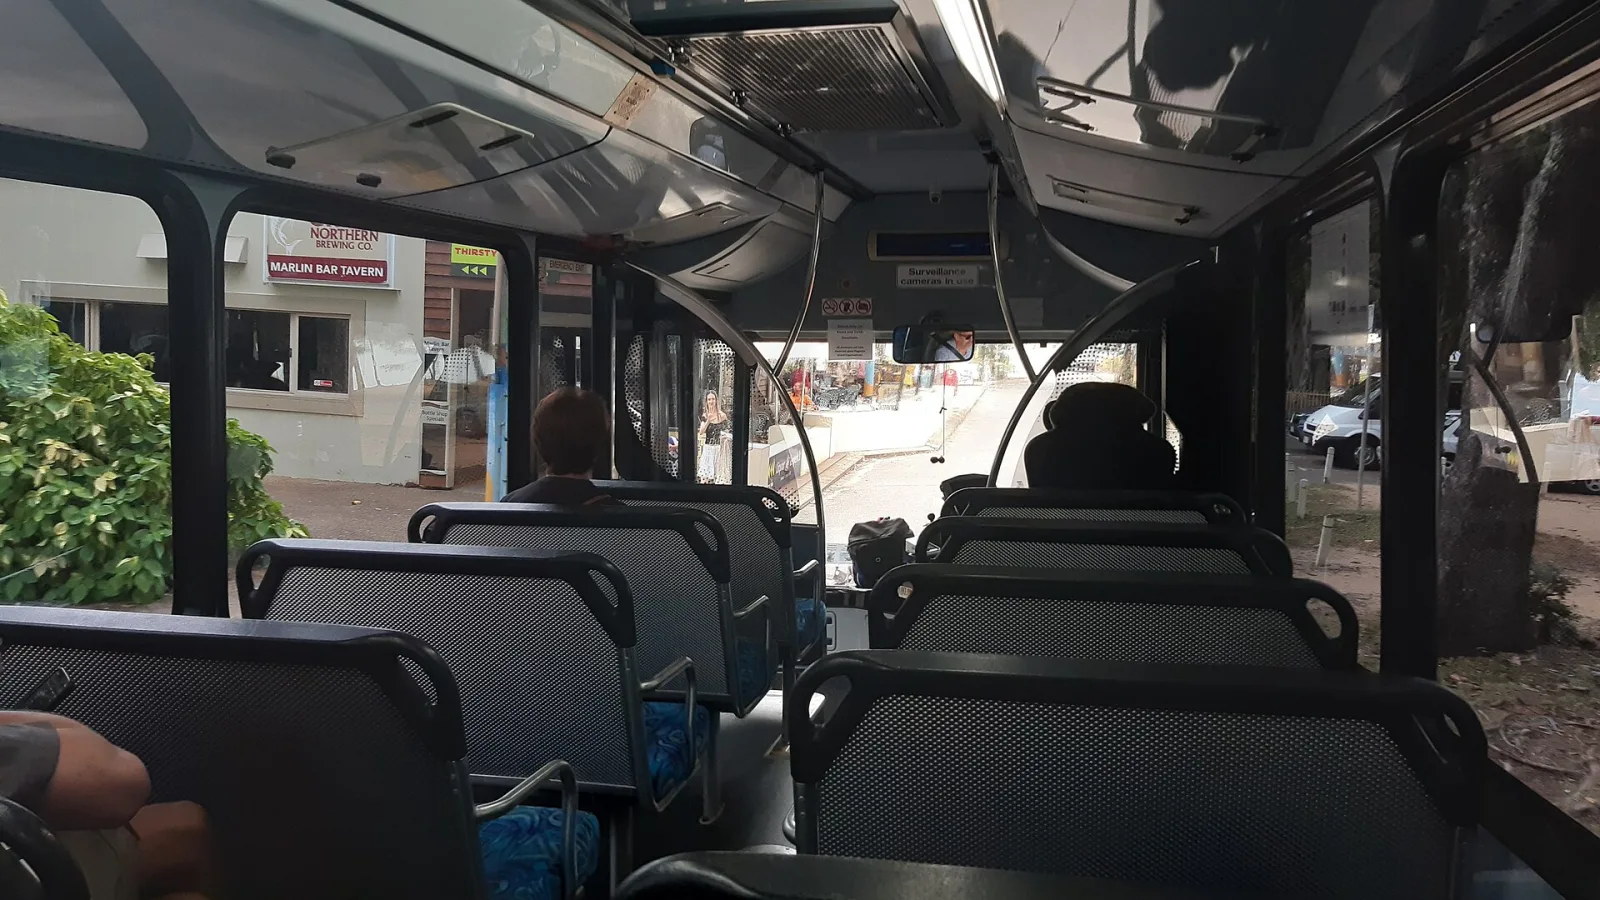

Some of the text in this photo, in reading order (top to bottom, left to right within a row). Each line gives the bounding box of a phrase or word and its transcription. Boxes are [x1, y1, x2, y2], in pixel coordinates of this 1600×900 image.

[310, 227, 379, 242] NORTHERN
[315, 240, 373, 251] BREWING CO.
[454, 247, 498, 257] THIRSTY
[270, 261, 384, 277] MARLIN BAR TAVERN
[908, 267, 966, 276] Surveillance
[945, 277, 954, 285] in
